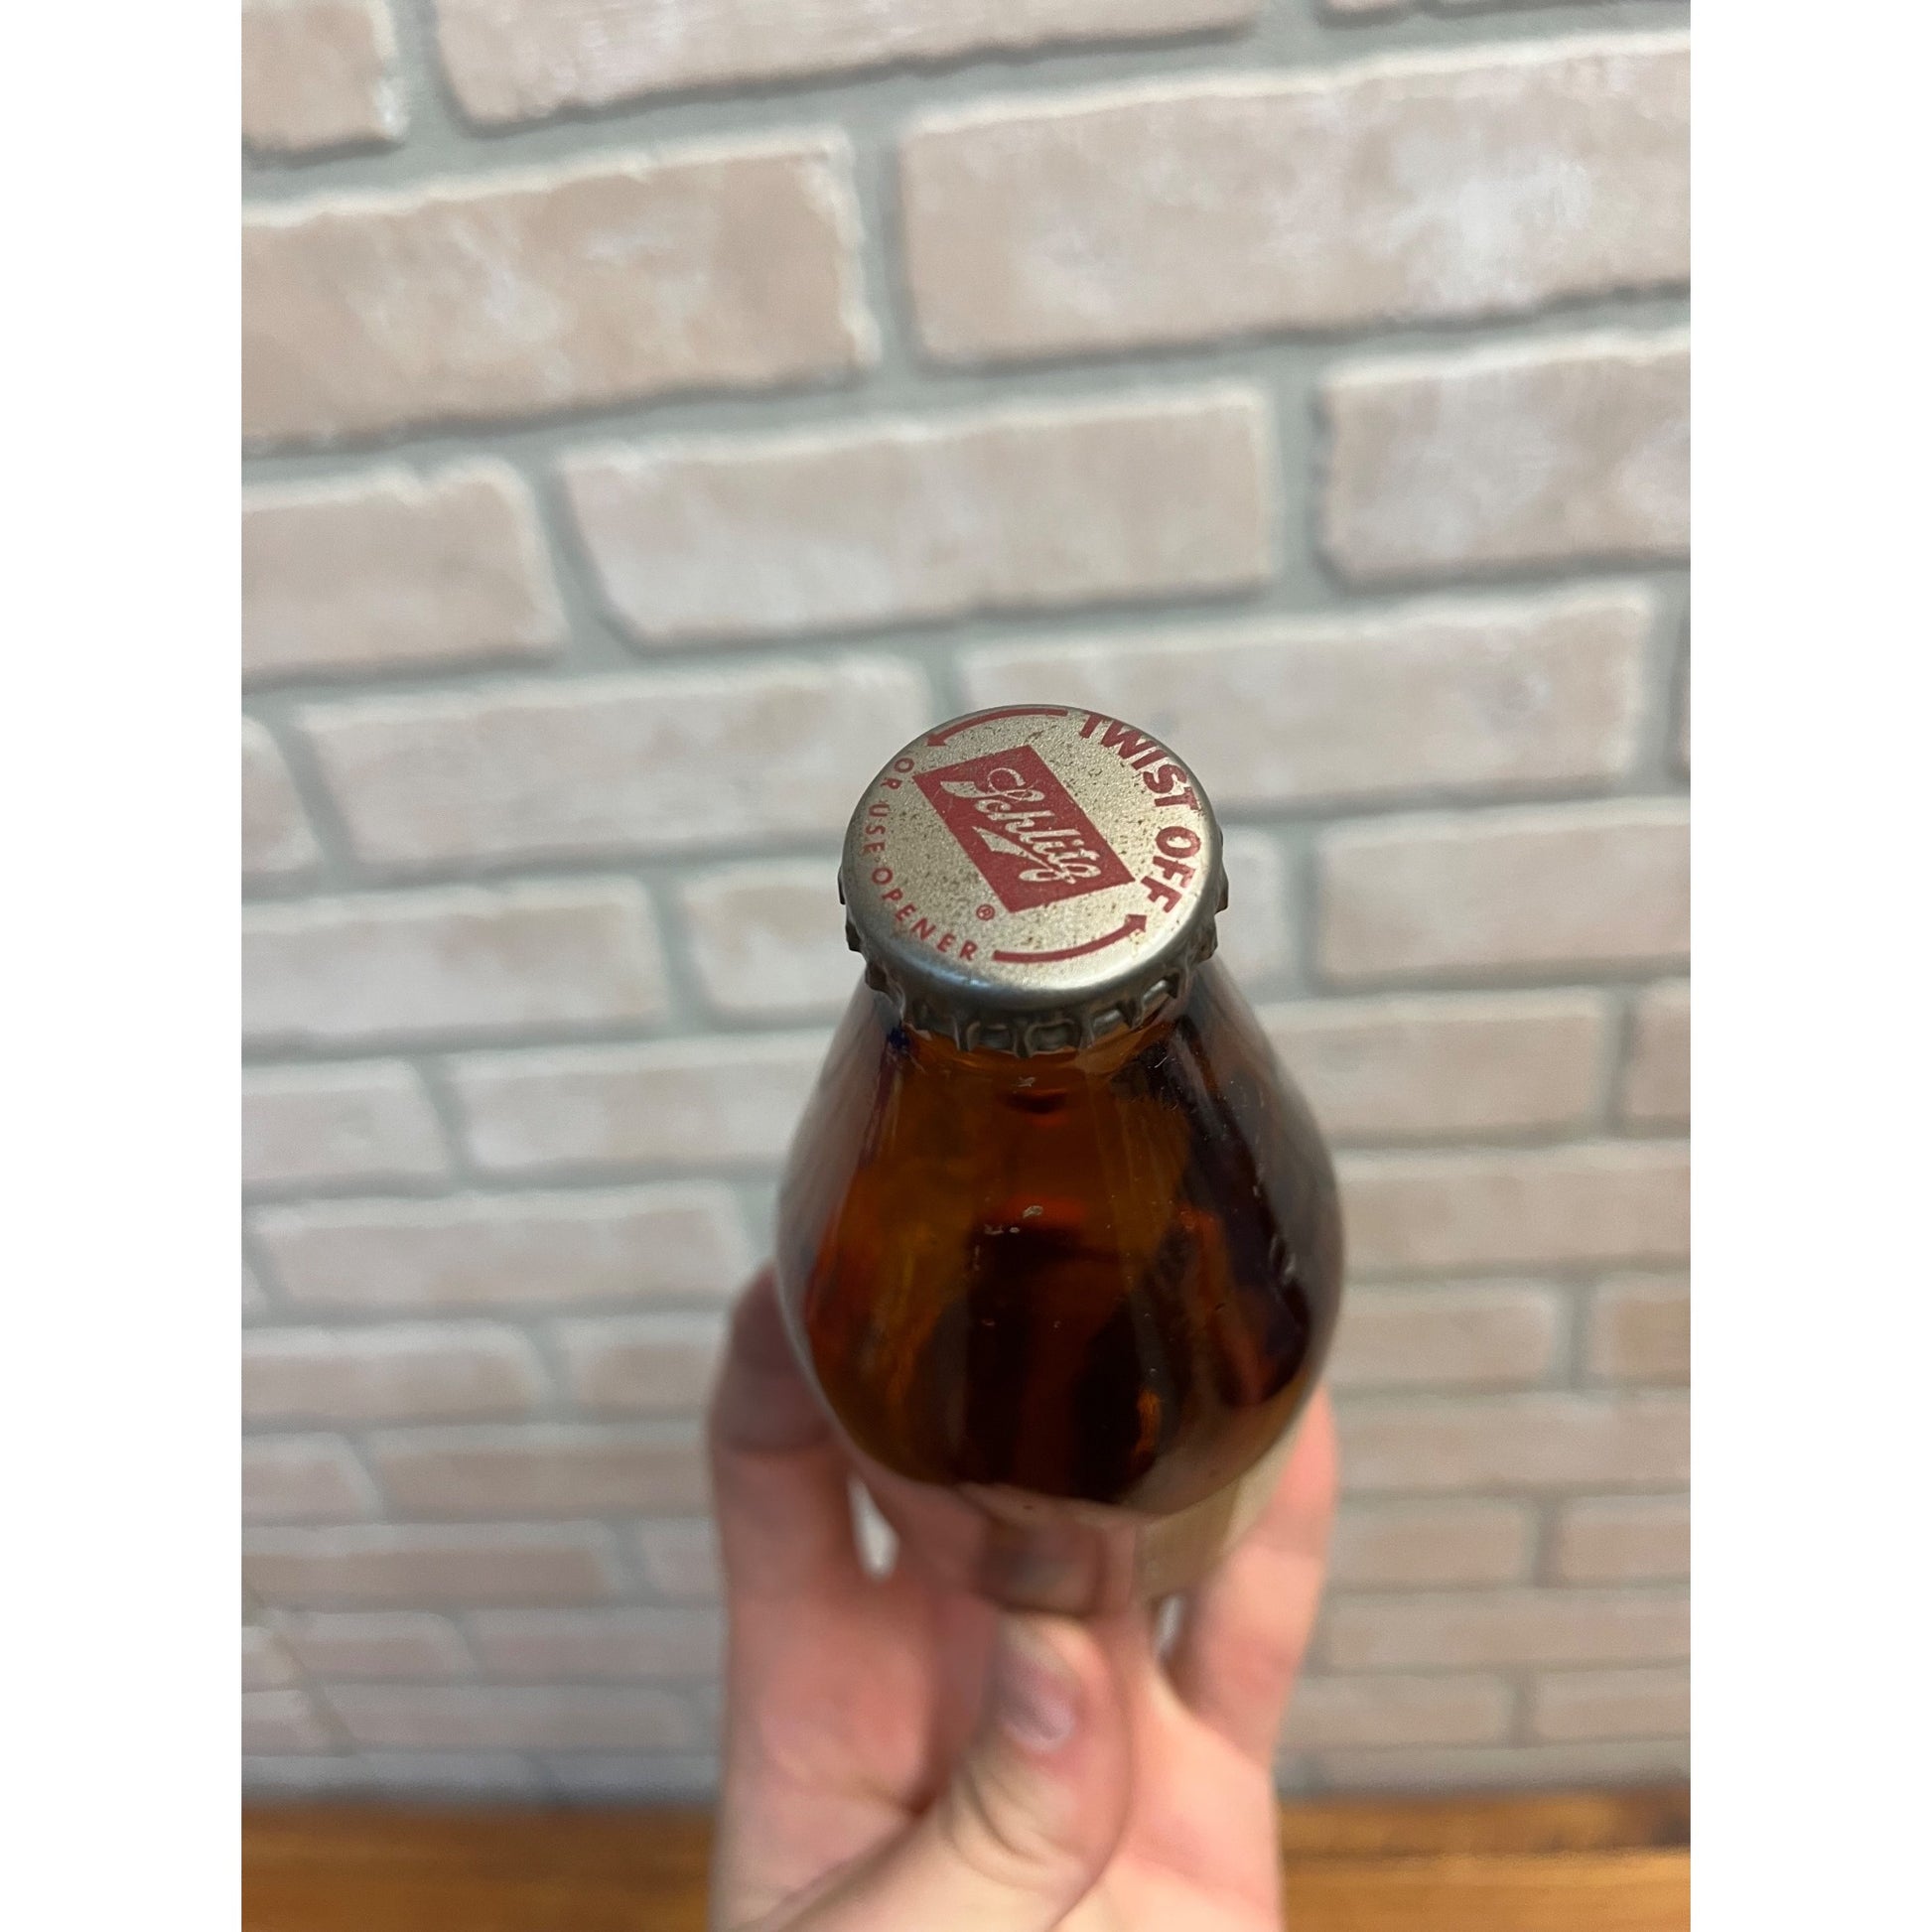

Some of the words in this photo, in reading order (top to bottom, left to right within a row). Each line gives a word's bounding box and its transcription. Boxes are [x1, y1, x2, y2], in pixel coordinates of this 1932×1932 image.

[880, 758, 915, 791] OR
[1079, 710, 1202, 811] TWIST
[862, 803, 892, 857] USE
[939, 767, 1102, 885] Schlitz
[1139, 826, 1202, 913] OFF
[871, 867, 979, 962] OPENER
